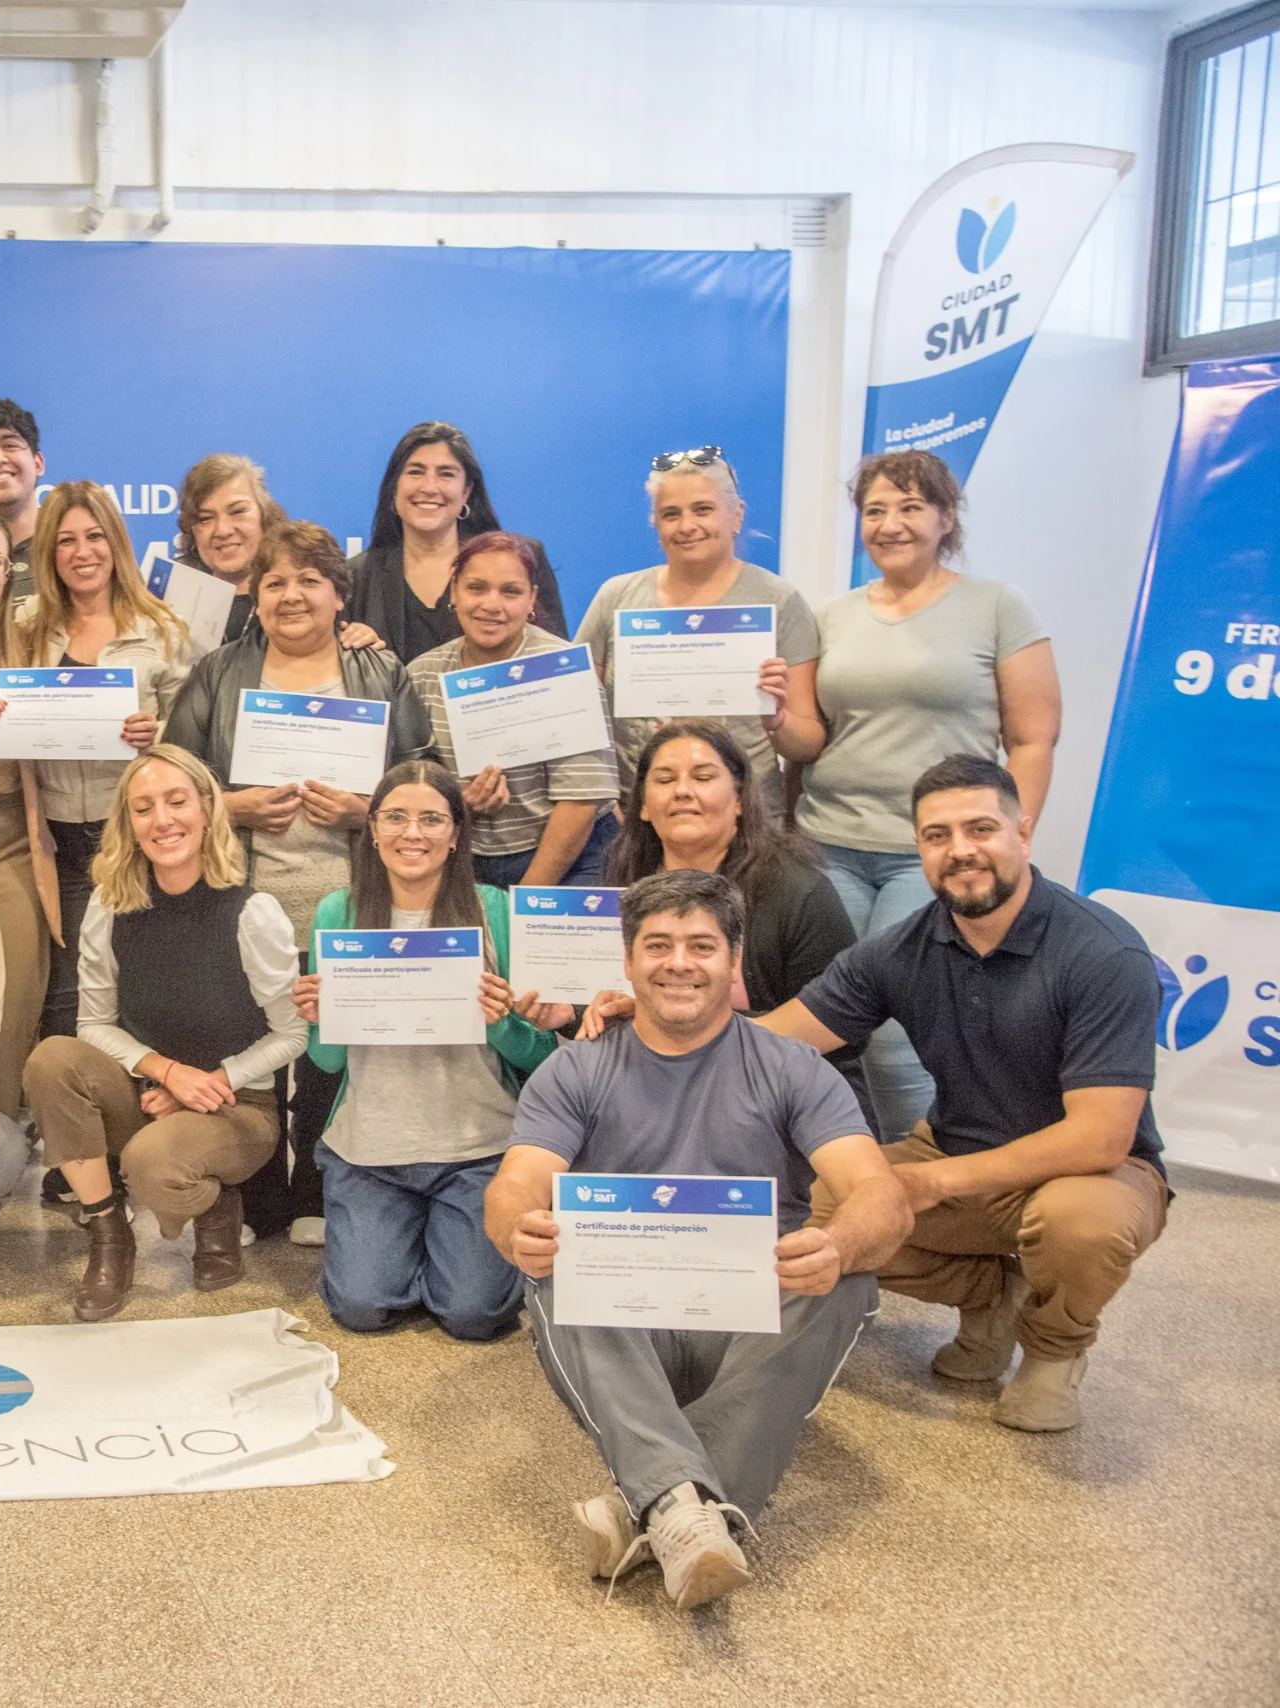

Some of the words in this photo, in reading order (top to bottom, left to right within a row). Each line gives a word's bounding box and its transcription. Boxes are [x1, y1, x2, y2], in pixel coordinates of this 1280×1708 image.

[941, 274, 1012, 310] CIUDAD
[924, 292, 1020, 361] SMT
[903, 412, 954, 439] ciudad
[1225, 622, 1280, 646] FER
[1173, 649, 1214, 695] 9
[1226, 653, 1280, 700] d
[592, 1194, 616, 1203] SMT
[575, 1222, 628, 1231] Certificado
[643, 1223, 708, 1235] participación
